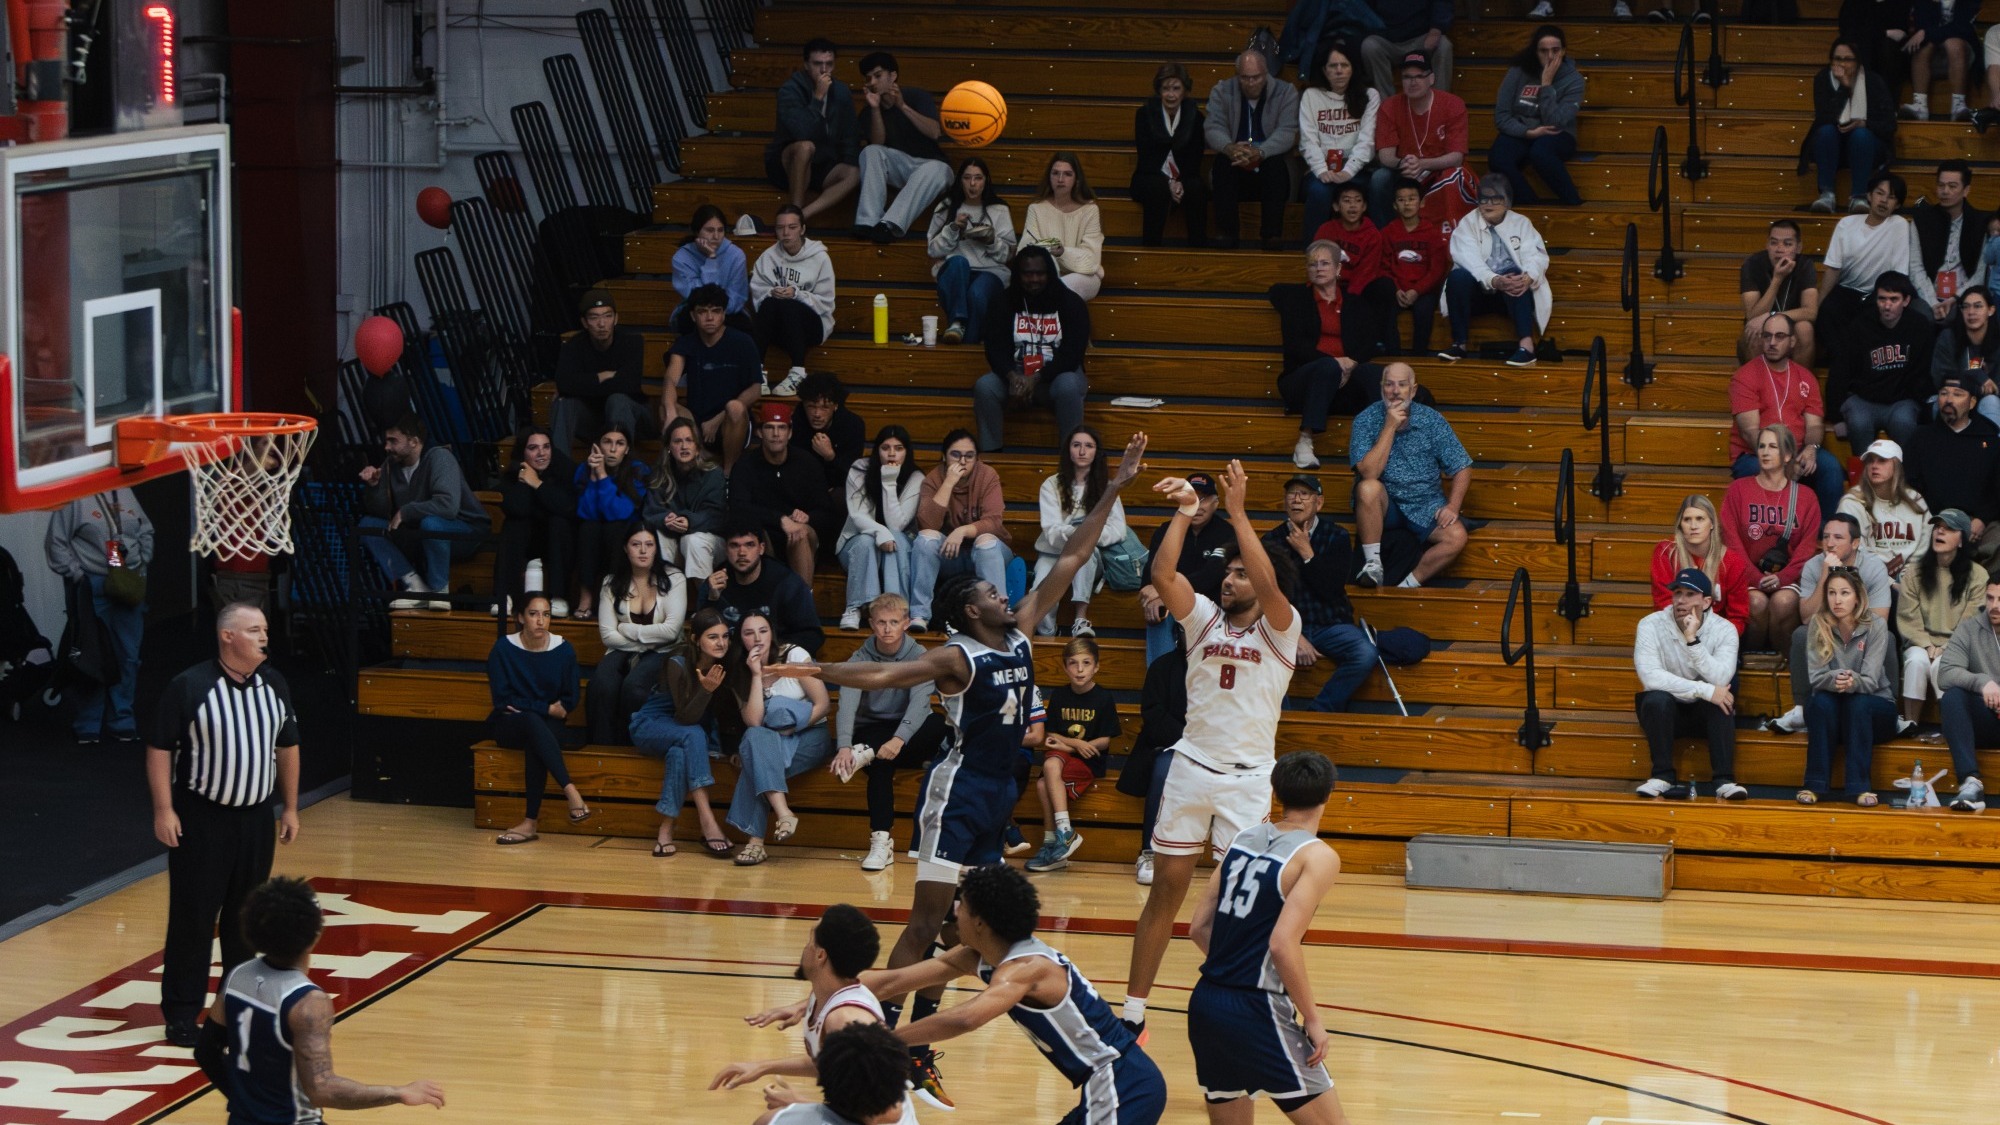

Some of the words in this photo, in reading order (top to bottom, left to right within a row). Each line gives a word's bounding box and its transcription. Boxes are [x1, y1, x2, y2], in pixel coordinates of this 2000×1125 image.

[1317, 108, 1361, 121] BIOL
[772, 266, 801, 283] MIBU
[1018, 318, 1057, 334] Brklyn
[1870, 344, 1910, 368] BIOL
[992, 666, 1029, 686] MENO
[1219, 663, 1237, 691] 8
[1218, 854, 1272, 919] 15
[236, 1006, 254, 1073] 1
